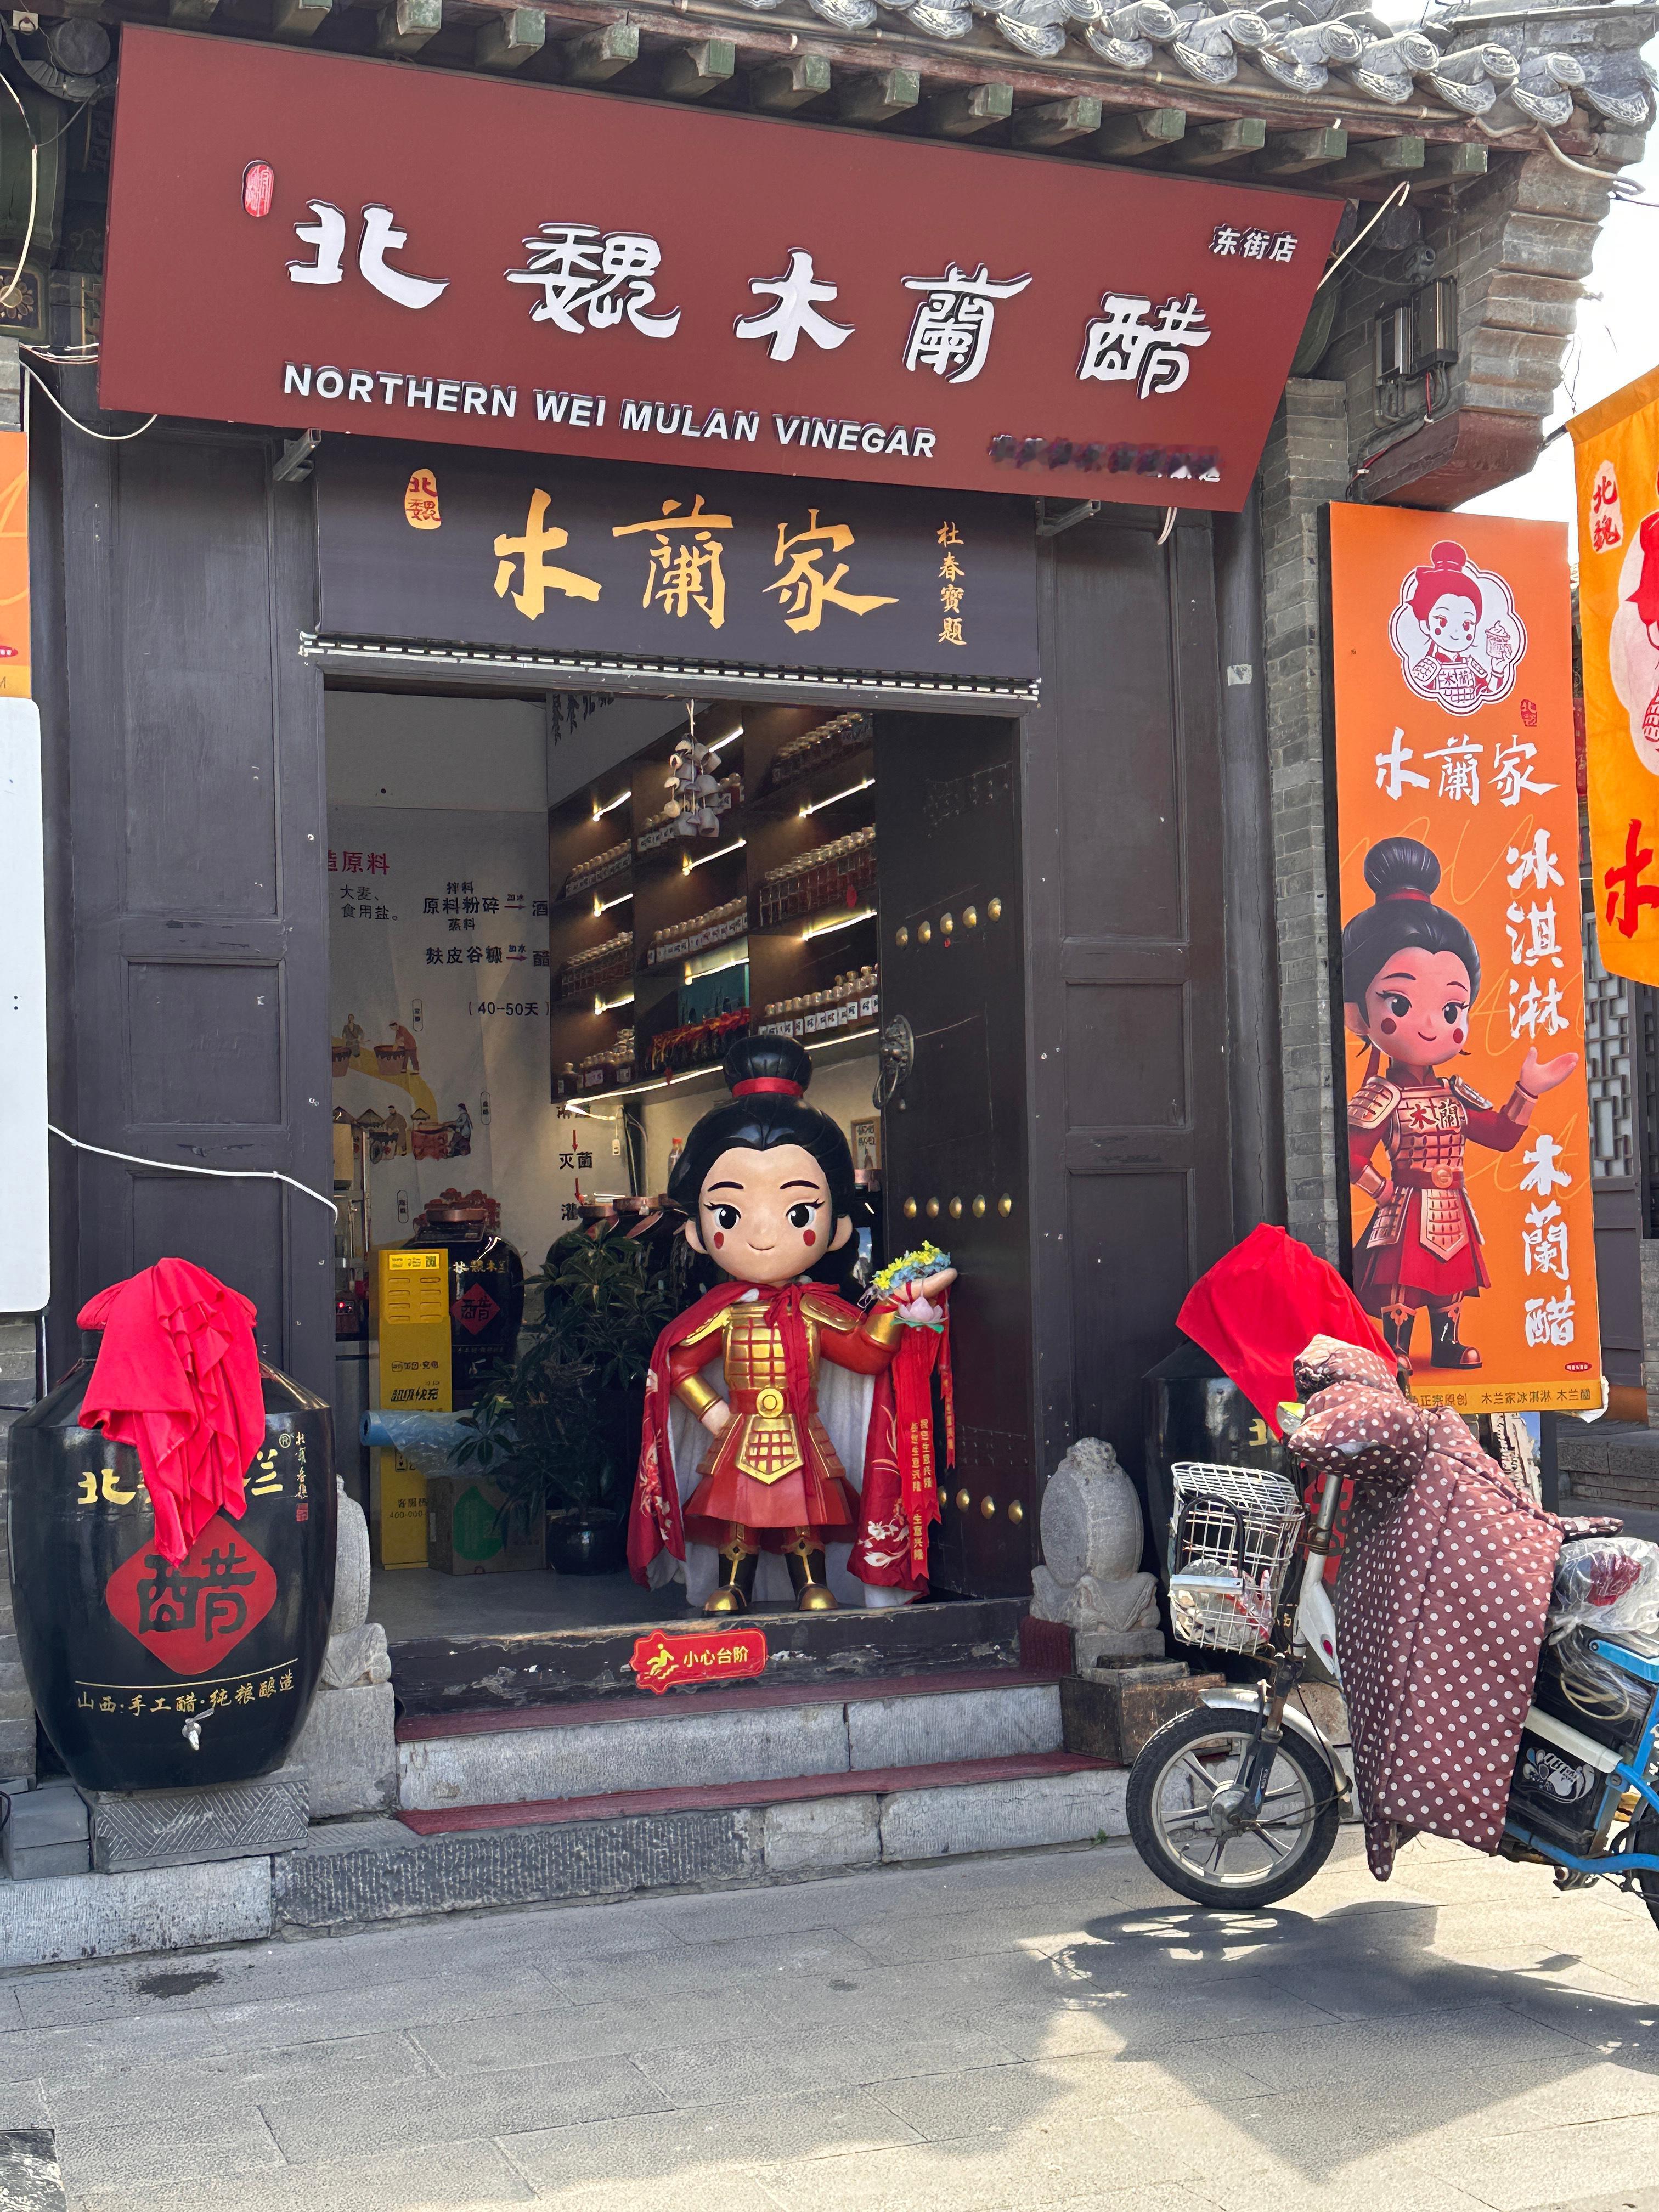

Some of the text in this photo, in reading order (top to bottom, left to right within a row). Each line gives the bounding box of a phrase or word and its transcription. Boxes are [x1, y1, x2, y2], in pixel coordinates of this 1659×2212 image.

[1210, 224, 1298, 263] 东街店
[284, 362, 936, 458] NORTHERN WEI MULAN VINEGAR
[406, 477, 441, 521] 北魏
[423, 896, 500, 914] 原料粉碎
[1506, 828, 1570, 1039] 冰淇淋
[559, 1152, 592, 1169] 灭菌
[1520, 1135, 1576, 1348] 木蘭醋
[461, 1297, 493, 1322] 醋
[137, 1542, 256, 1642] 醋
[684, 1646, 748, 1667] 小心台阶
